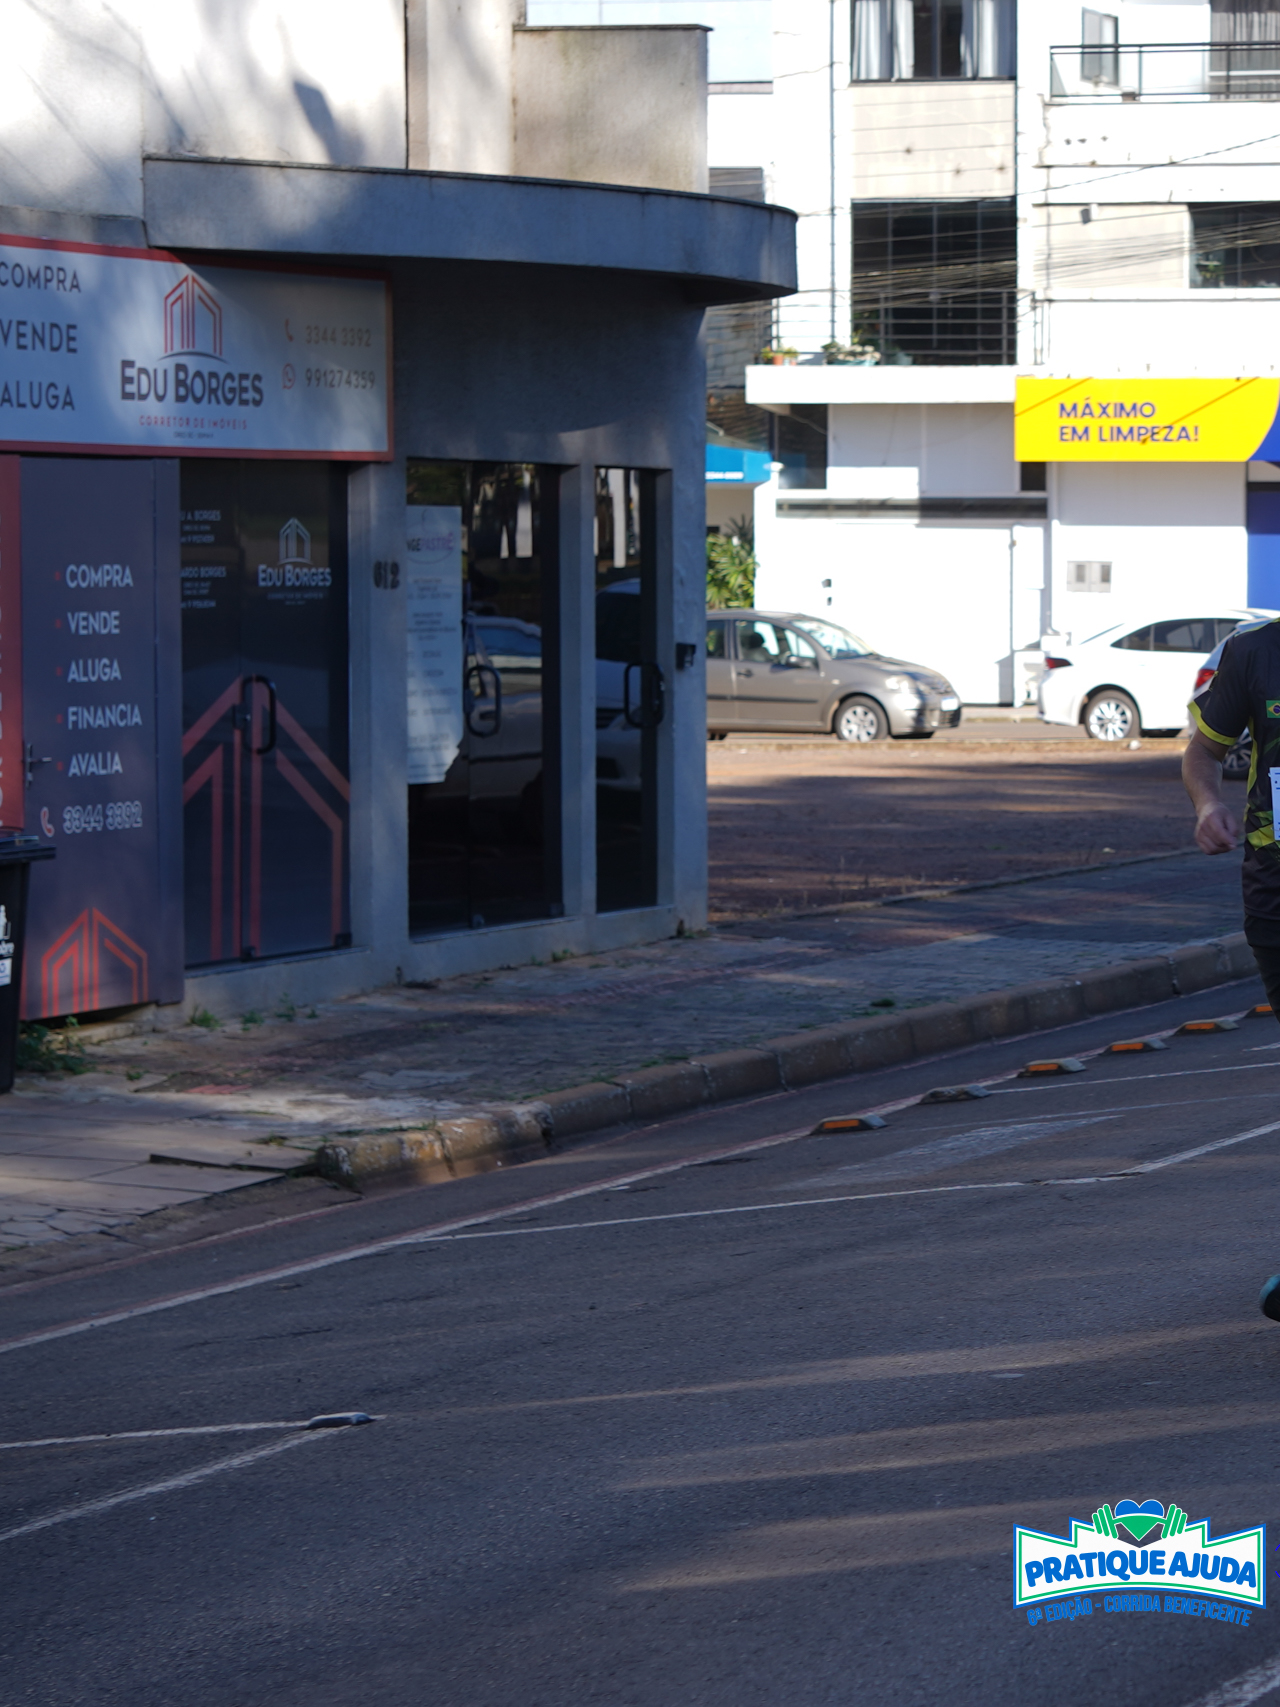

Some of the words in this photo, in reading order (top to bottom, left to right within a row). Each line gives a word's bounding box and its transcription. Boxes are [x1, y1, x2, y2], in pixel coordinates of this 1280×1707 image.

[0, 262, 82, 293] COMPRA
[0, 319, 78, 354] VENDE
[305, 325, 337, 346] 3344
[341, 327, 371, 348] 3392
[174, 363, 264, 408] BORGES
[305, 367, 375, 390] 991274359
[0, 381, 76, 412] ALUGA
[1059, 397, 1157, 419] MÁXIMO
[1059, 425, 1091, 443] EM
[1098, 425, 1200, 443] LIMPEZA!
[66, 564, 134, 589] COMPRA
[257, 564, 283, 587] EDU
[285, 565, 332, 587] BORGES
[67, 611, 121, 635] VENDE
[67, 658, 122, 683] ALUGA
[67, 703, 143, 730] FINANCIA
[68, 752, 123, 777] AVALIA
[63, 801, 104, 834] 3344
